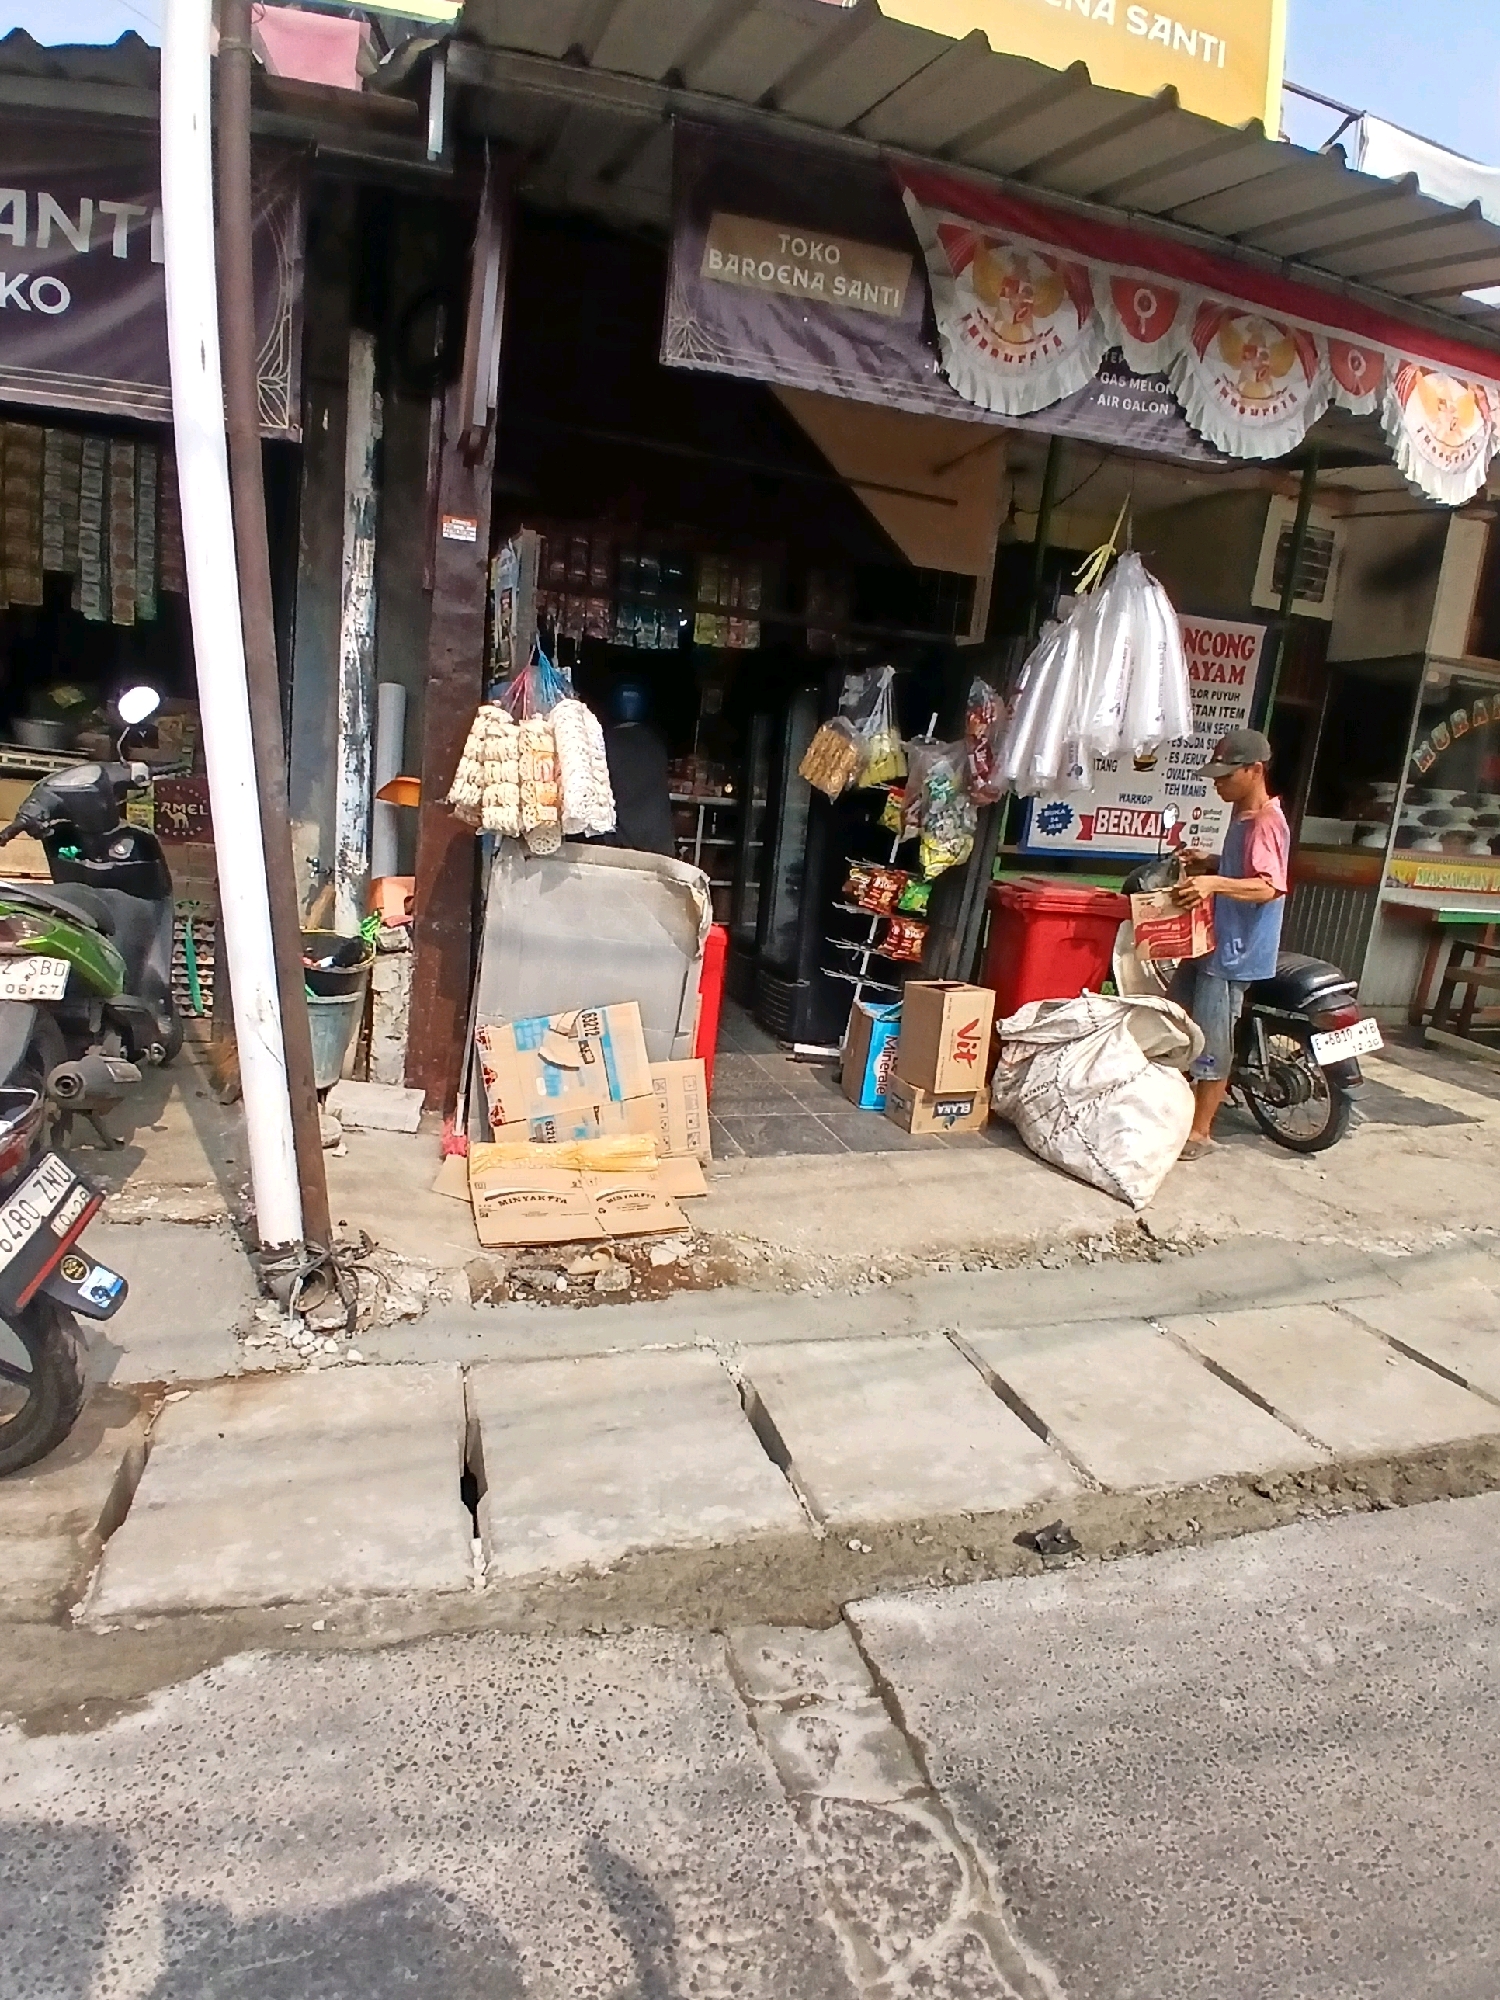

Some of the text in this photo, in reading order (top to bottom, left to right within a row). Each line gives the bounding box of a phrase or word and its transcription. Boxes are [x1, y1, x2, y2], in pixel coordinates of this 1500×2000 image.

[1045, 0, 1226, 68] NA SANTI
[778, 233, 840, 264] TOKO
[708, 249, 899, 308] BAROENA SANTI
[0, 272, 71, 314] KO
[1101, 372, 1175, 395] GAS MELON
[1097, 394, 1169, 415] AIR GALON
[1189, 660, 1246, 686] AYAM
[1211, 690, 1241, 701] PUYUH
[1219, 706, 1246, 720] ITEM
[1168, 751, 1208, 766] ES JERUK
[1119, 792, 1153, 805] WARKOP
[1164, 783, 1180, 796] TEH
[29, 959, 66, 977] SBD
[952, 1018, 982, 1069] Vit
[876, 1033, 899, 1095] Minerale
[33, 1160, 72, 1203] ZNU
